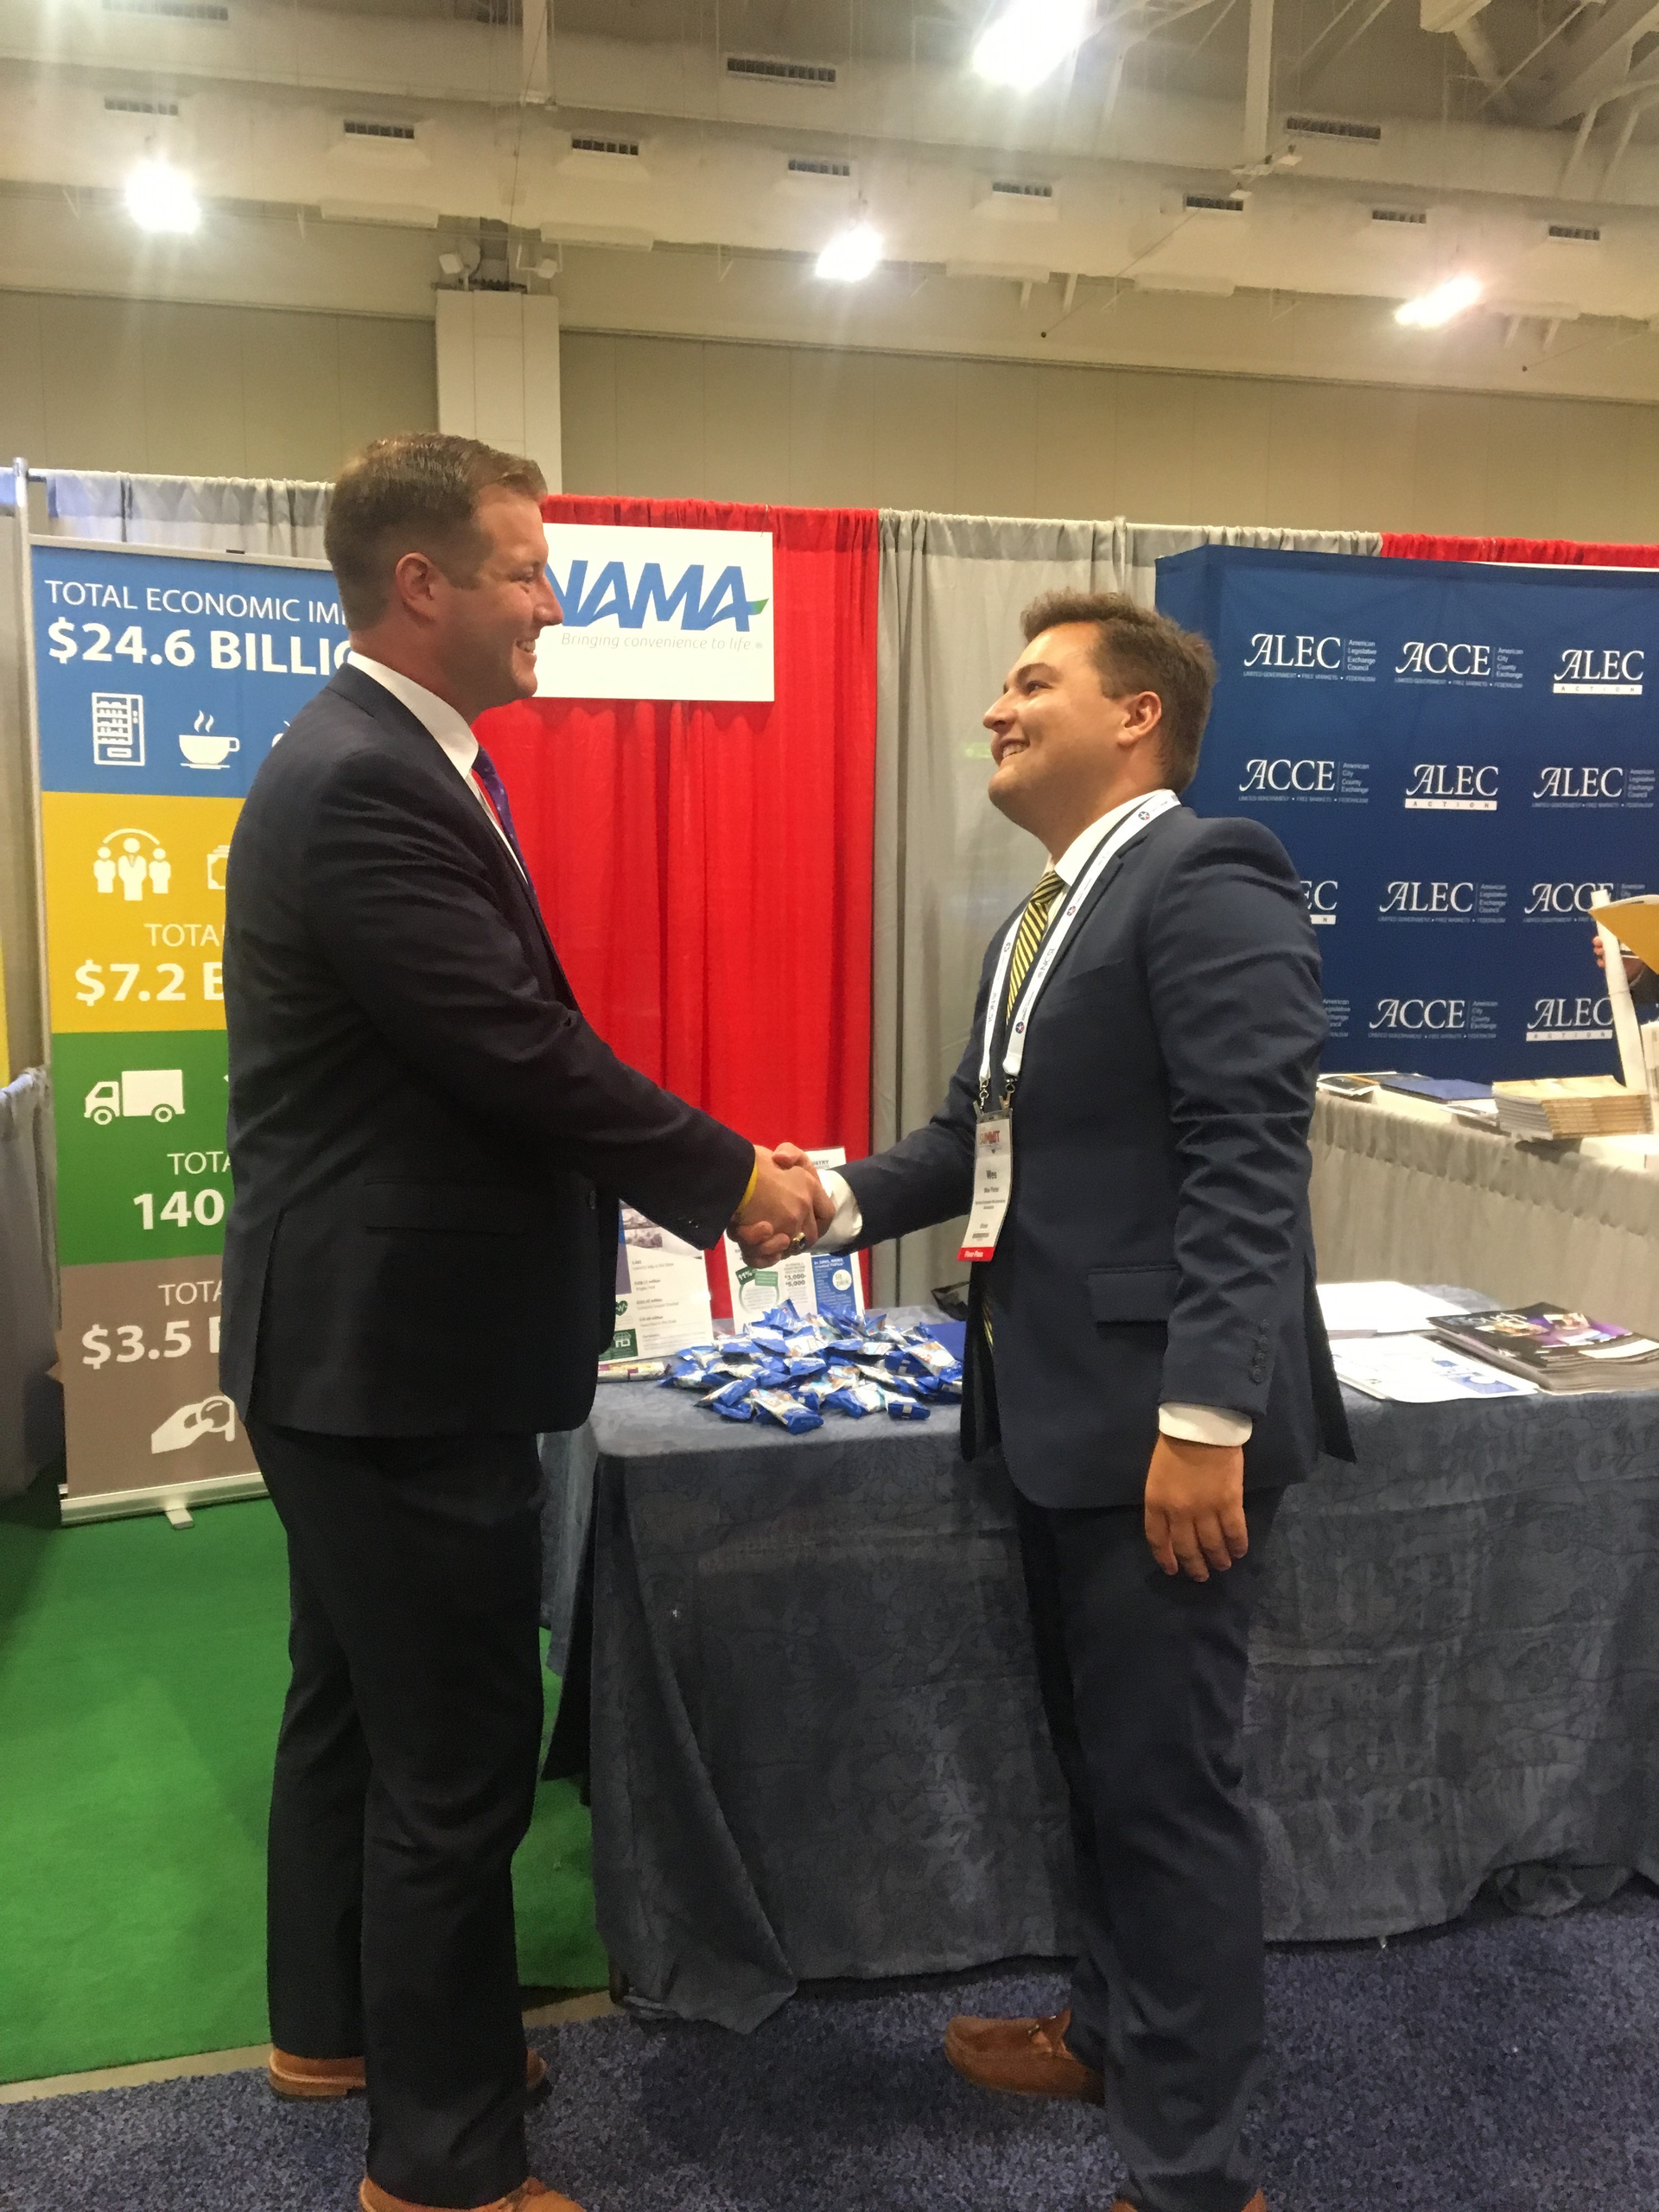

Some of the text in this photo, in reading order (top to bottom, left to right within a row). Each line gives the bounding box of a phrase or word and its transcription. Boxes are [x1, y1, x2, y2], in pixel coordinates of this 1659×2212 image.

[45, 580, 137, 609] TOTAL
[146, 588, 300, 621] ECONOMIC
[48, 617, 195, 666] $24.6
[562, 632, 620, 649] Bringing
[624, 636, 707, 648] convenience
[711, 639, 724, 649] to
[1244, 633, 1340, 669] ALEC
[1347, 656, 1376, 665] Exchange
[1395, 642, 1491, 676] ACCE
[1554, 649, 1644, 681] ALEC
[1239, 760, 1335, 791] ACCE
[1406, 764, 1498, 796] ALEC
[1533, 767, 1624, 798] ALEC
[1379, 881, 1473, 912] ALEC
[144, 924, 225, 947] TOTA
[75, 959, 186, 1007] $7.2
[1369, 999, 1465, 1029] ACCE
[1527, 998, 1613, 1029] ALEC
[133, 1189, 225, 1230] 140
[82, 1320, 191, 1370] $3.5
